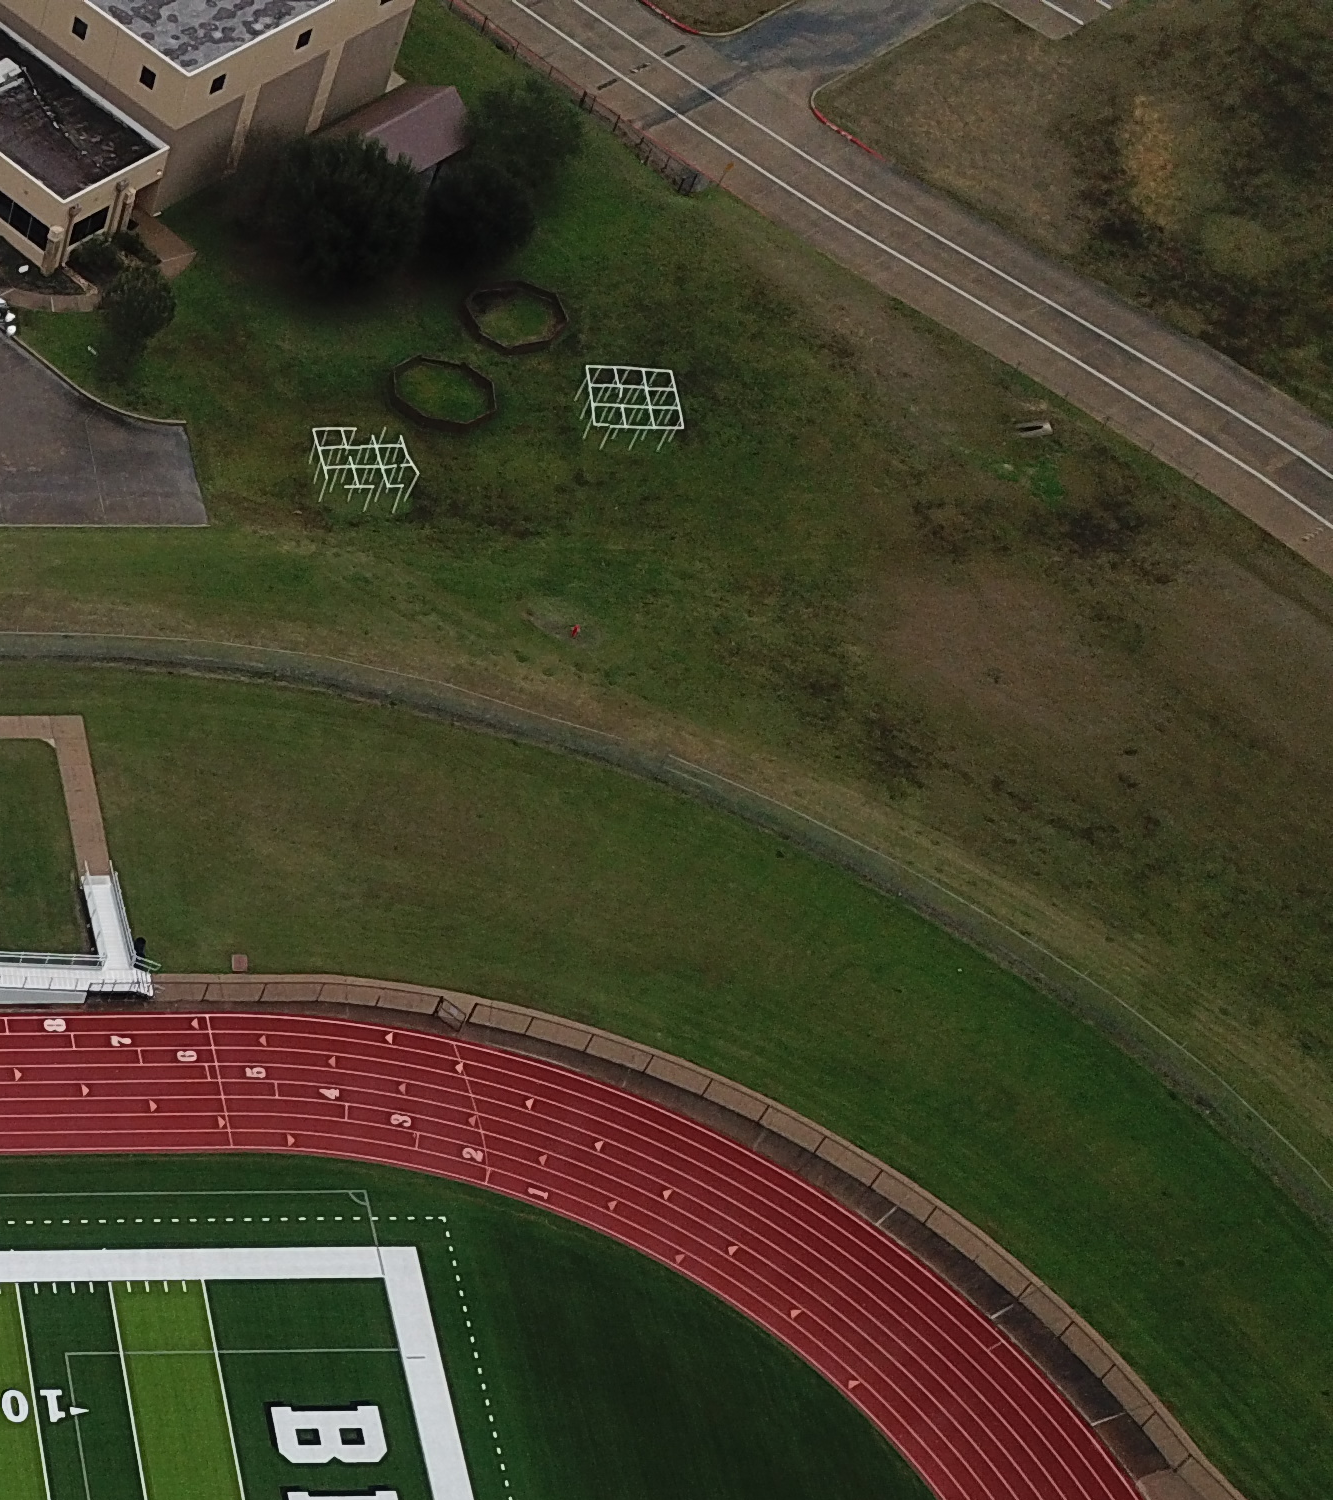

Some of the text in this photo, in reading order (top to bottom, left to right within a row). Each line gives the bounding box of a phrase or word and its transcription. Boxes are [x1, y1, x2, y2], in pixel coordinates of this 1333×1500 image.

[43, 1018, 67, 1033] 8
[109, 1035, 133, 1047] 7
[176, 1050, 198, 1062] 6
[244, 1066, 267, 1079] 5
[318, 1088, 340, 1100] 4
[390, 1113, 412, 1128] 3
[461, 1147, 484, 1163] 2
[527, 1187, 549, 1200] 1
[2, 1389, 67, 1423] 10
